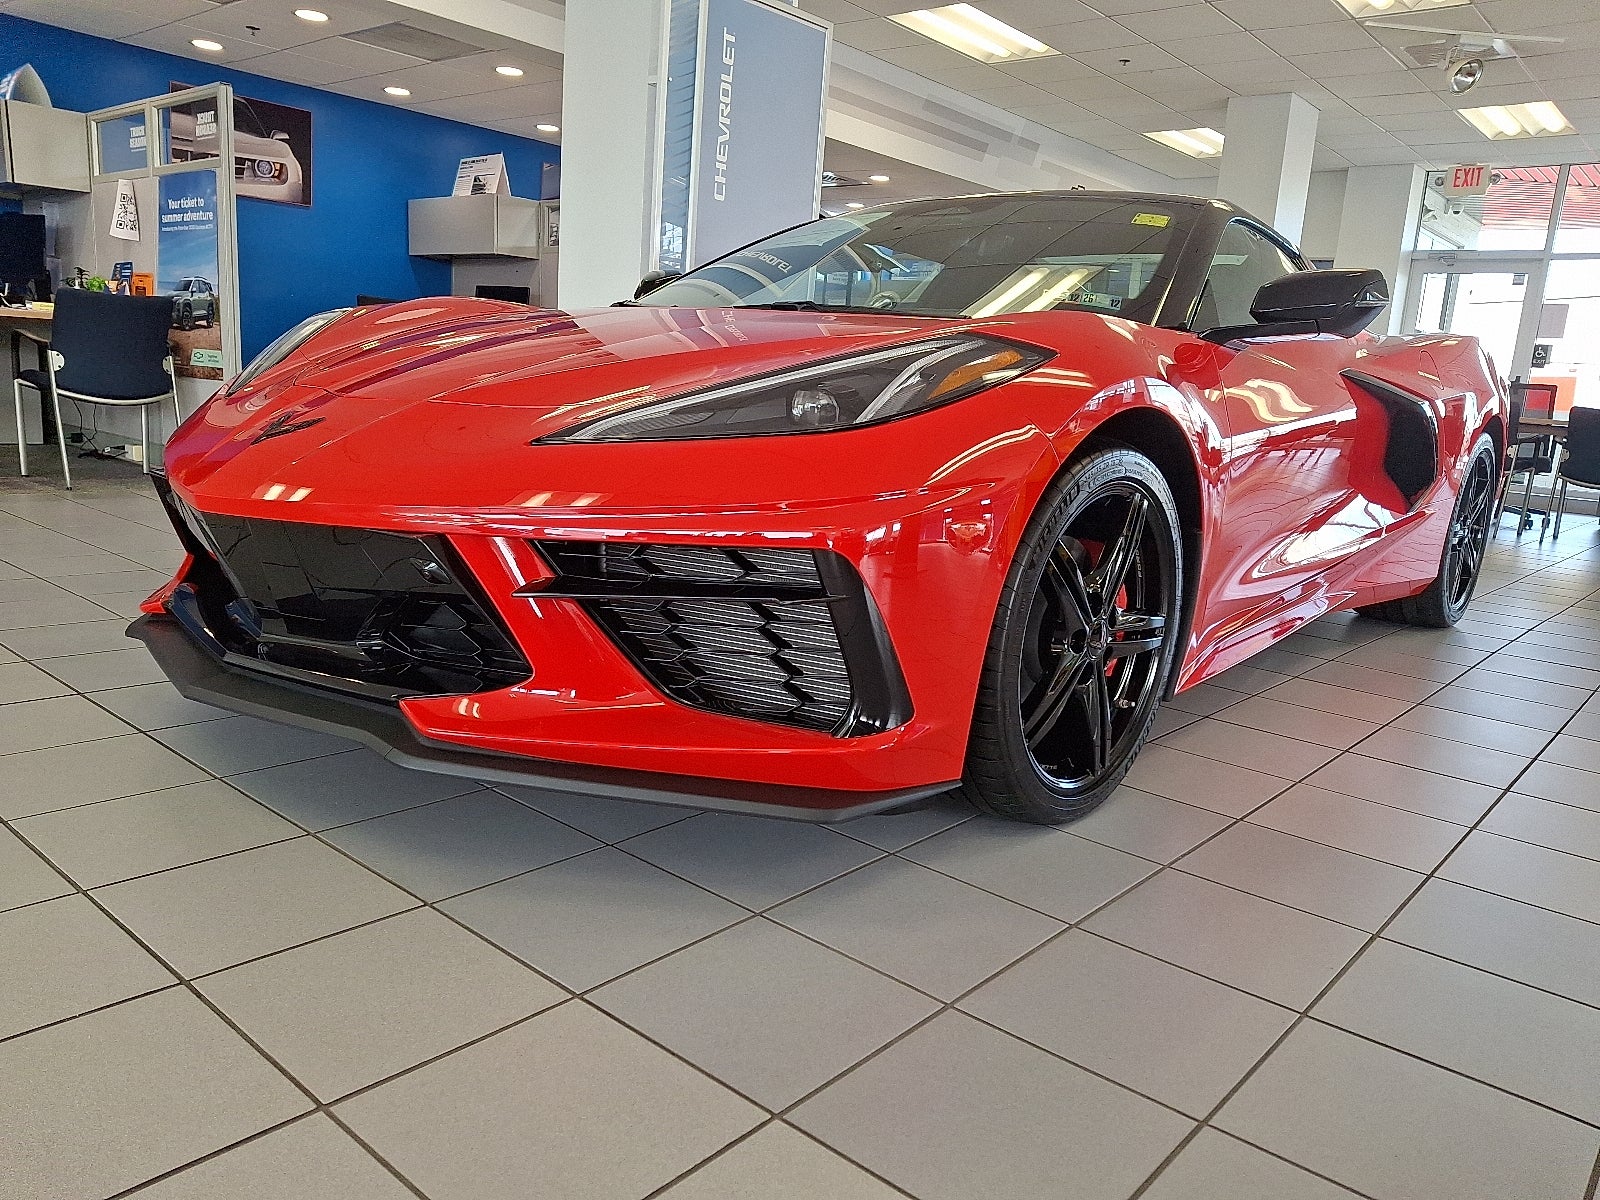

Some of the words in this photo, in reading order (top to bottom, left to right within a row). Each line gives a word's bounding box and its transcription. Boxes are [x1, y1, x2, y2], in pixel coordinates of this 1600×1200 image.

[713, 26, 736, 202] CHEVROLET
[1452, 167, 1484, 188] EXIT
[168, 198, 180, 209] Your
[180, 196, 197, 208] ticket
[197, 196, 205, 207] to
[161, 213, 184, 223] summer
[183, 210, 214, 222] adventure
[1083, 293, 1095, 303] 26
[1109, 298, 1121, 309] 12
